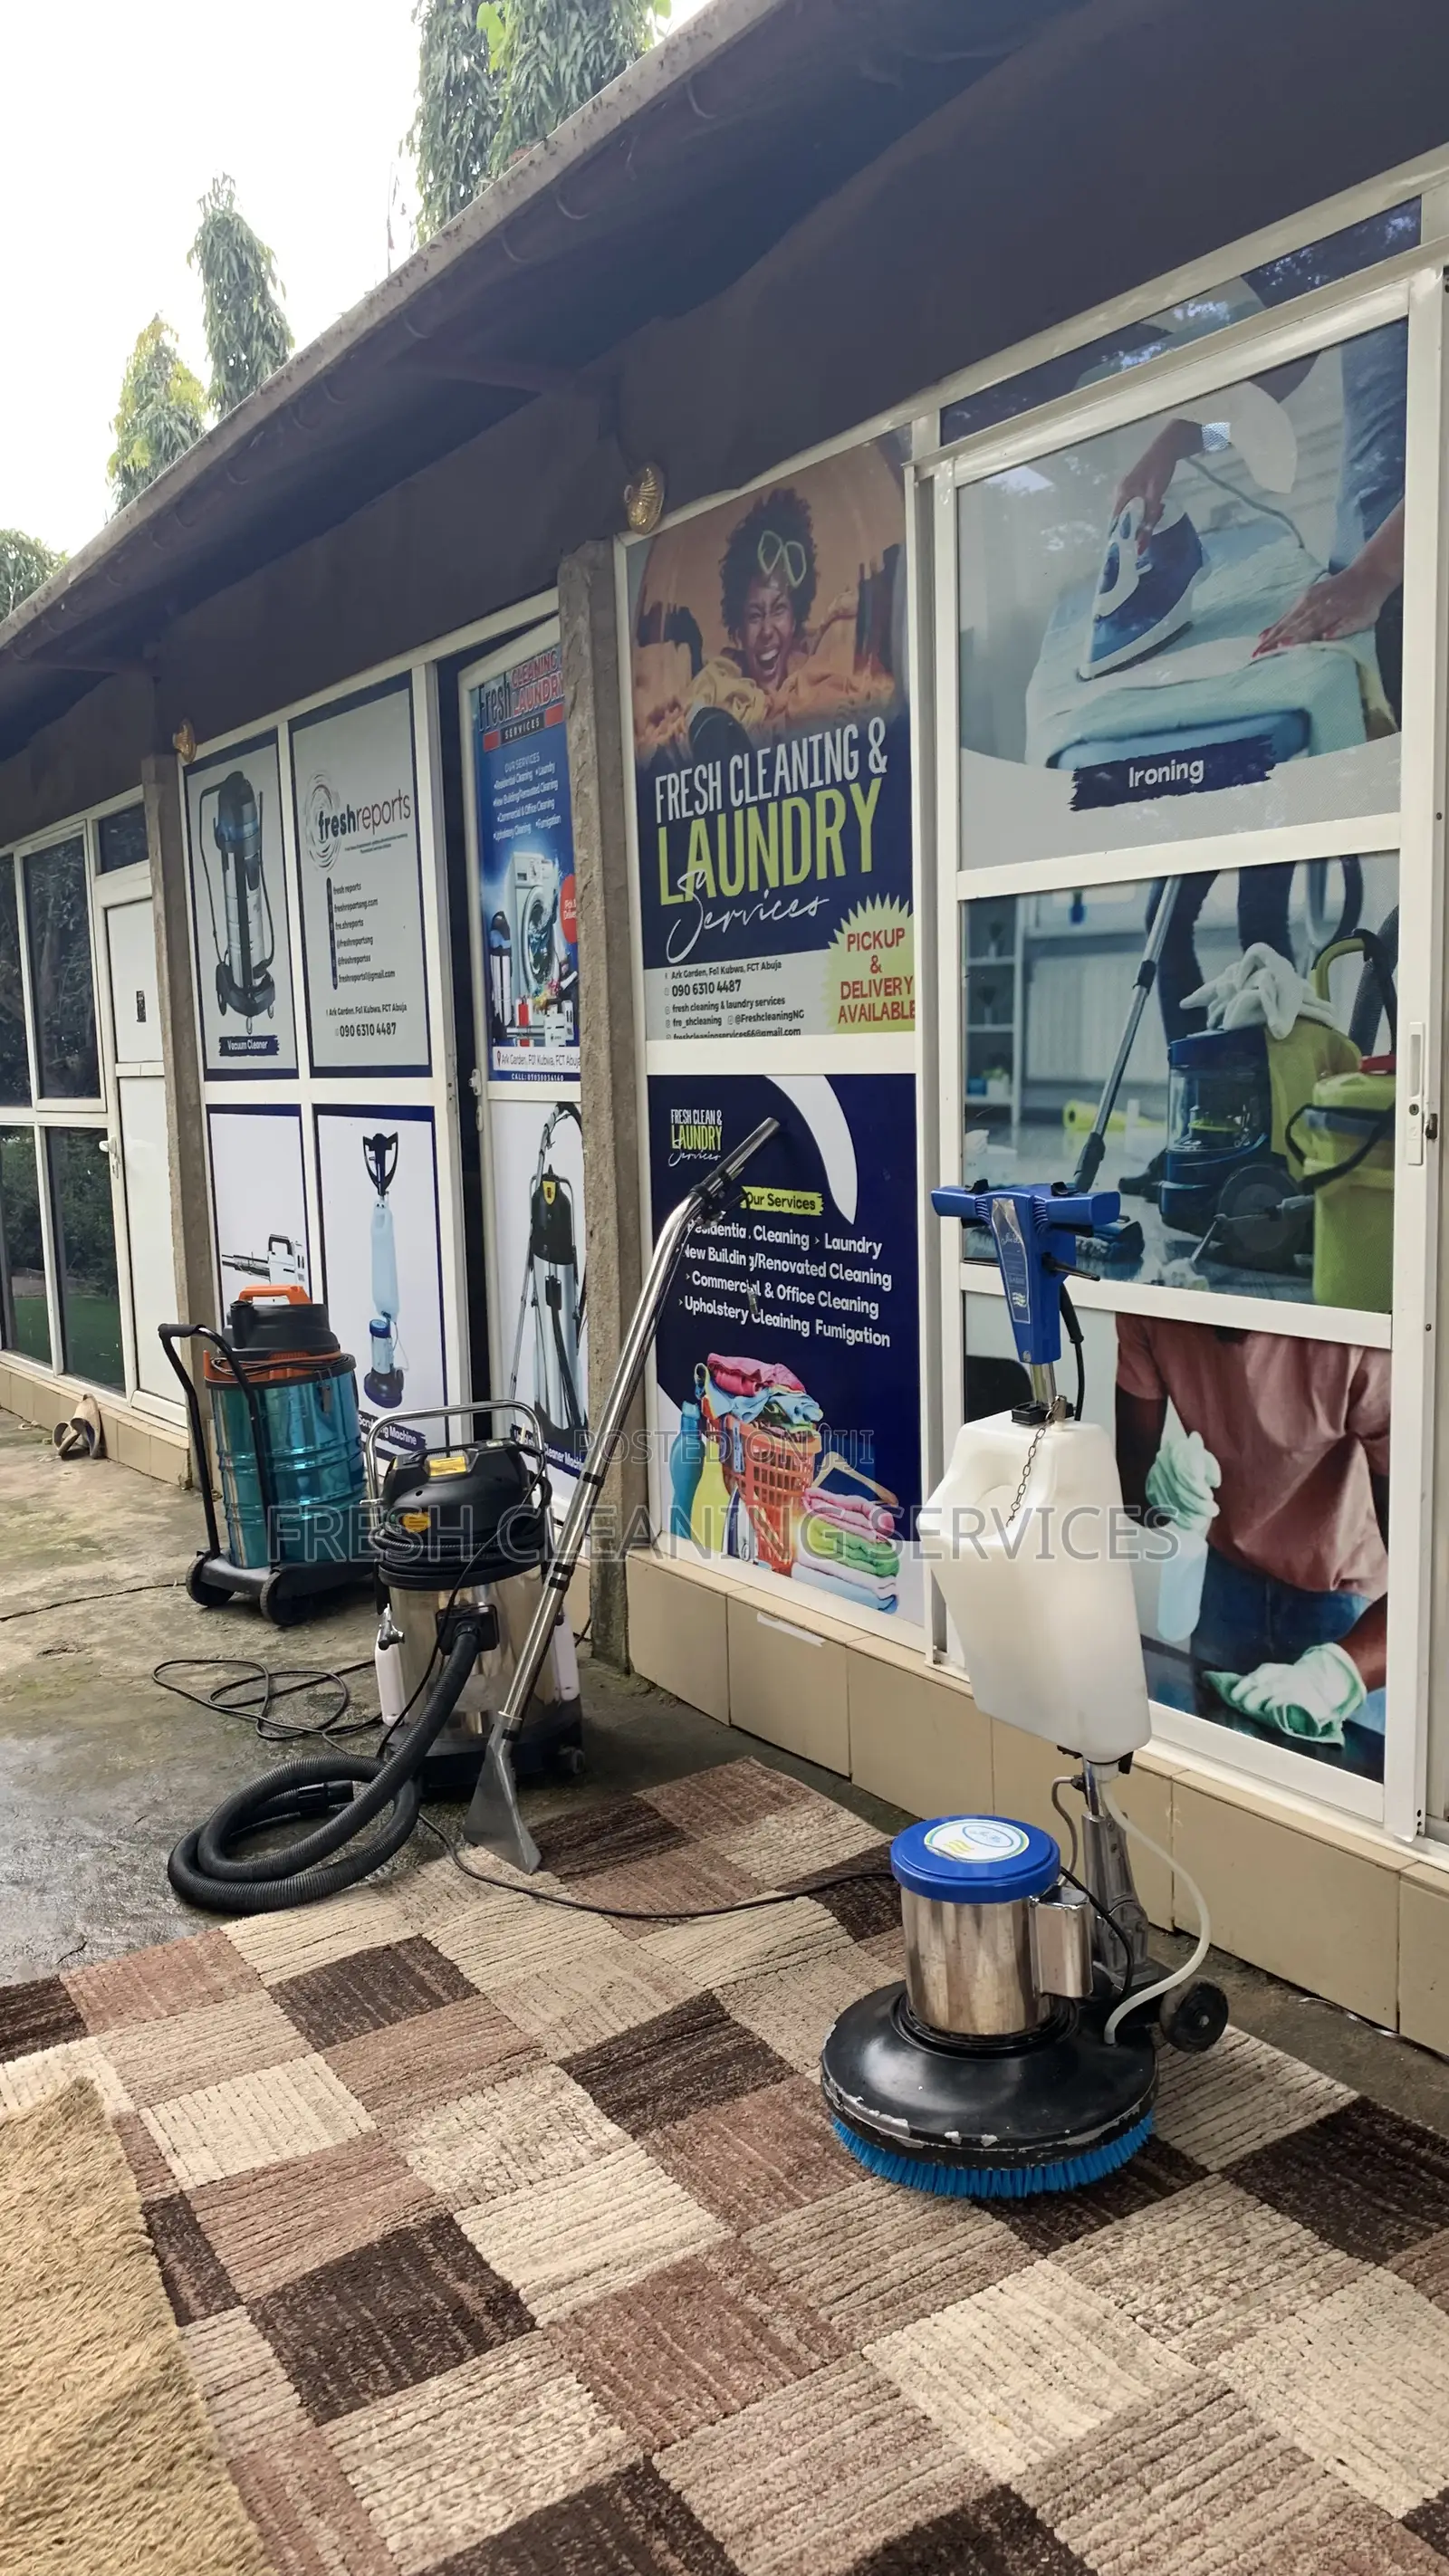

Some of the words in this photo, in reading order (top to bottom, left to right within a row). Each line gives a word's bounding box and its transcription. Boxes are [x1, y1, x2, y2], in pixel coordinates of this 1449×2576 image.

[504, 717, 540, 740] SERVICES
[656, 760, 723, 824] FRESH
[728, 723, 859, 808] CLEANING
[868, 716, 888, 774] &
[1129, 759, 1204, 788] Ironing
[318, 789, 411, 841] freshreports
[657, 777, 883, 906] LAUNDRY
[666, 868, 830, 963] Services
[847, 927, 905, 952] PICKUP
[671, 969, 683, 979] Ark
[746, 962, 760, 972] FCT
[761, 960, 782, 971] Abuja
[870, 954, 882, 973] &
[672, 984, 691, 997] 090
[692, 982, 715, 995] 6310
[716, 979, 742, 992] 4487
[840, 975, 913, 1001] DELIVERY
[382, 1003, 391, 1012] FCT
[672, 1004, 689, 1013] fresh
[690, 1001, 719, 1012] cleaning
[721, 1001, 724, 1010] &
[726, 998, 753, 1010] laundry
[755, 996, 785, 1007] services
[838, 1000, 915, 1024] AVAILABLE
[340, 1024, 355, 1038] 090
[356, 1023, 375, 1037] 6310
[376, 1022, 397, 1035] 4487
[227, 1040, 246, 1050] Vacuum
[247, 1039, 268, 1049] Cleaner
[670, 1109, 692, 1125] FRESH
[693, 1109, 715, 1125] CLEAN
[716, 1110, 723, 1125] &
[671, 1125, 723, 1151] LAUNDRY
[668, 1139, 721, 1167] Services
[767, 1192, 816, 1211] Services
[753, 1225, 810, 1250] Cleaning
[825, 1233, 882, 1259] Laundry
[829, 1263, 892, 1289] Cleaning
[692, 1270, 762, 1296] Commercial
[764, 1282, 774, 1298] &
[777, 1284, 815, 1305] Office
[818, 1290, 879, 1320] Cleaning
[684, 1295, 749, 1325] Upholstery
[815, 1318, 890, 1347] Fumigation
[389, 1425, 417, 1445] Machine
